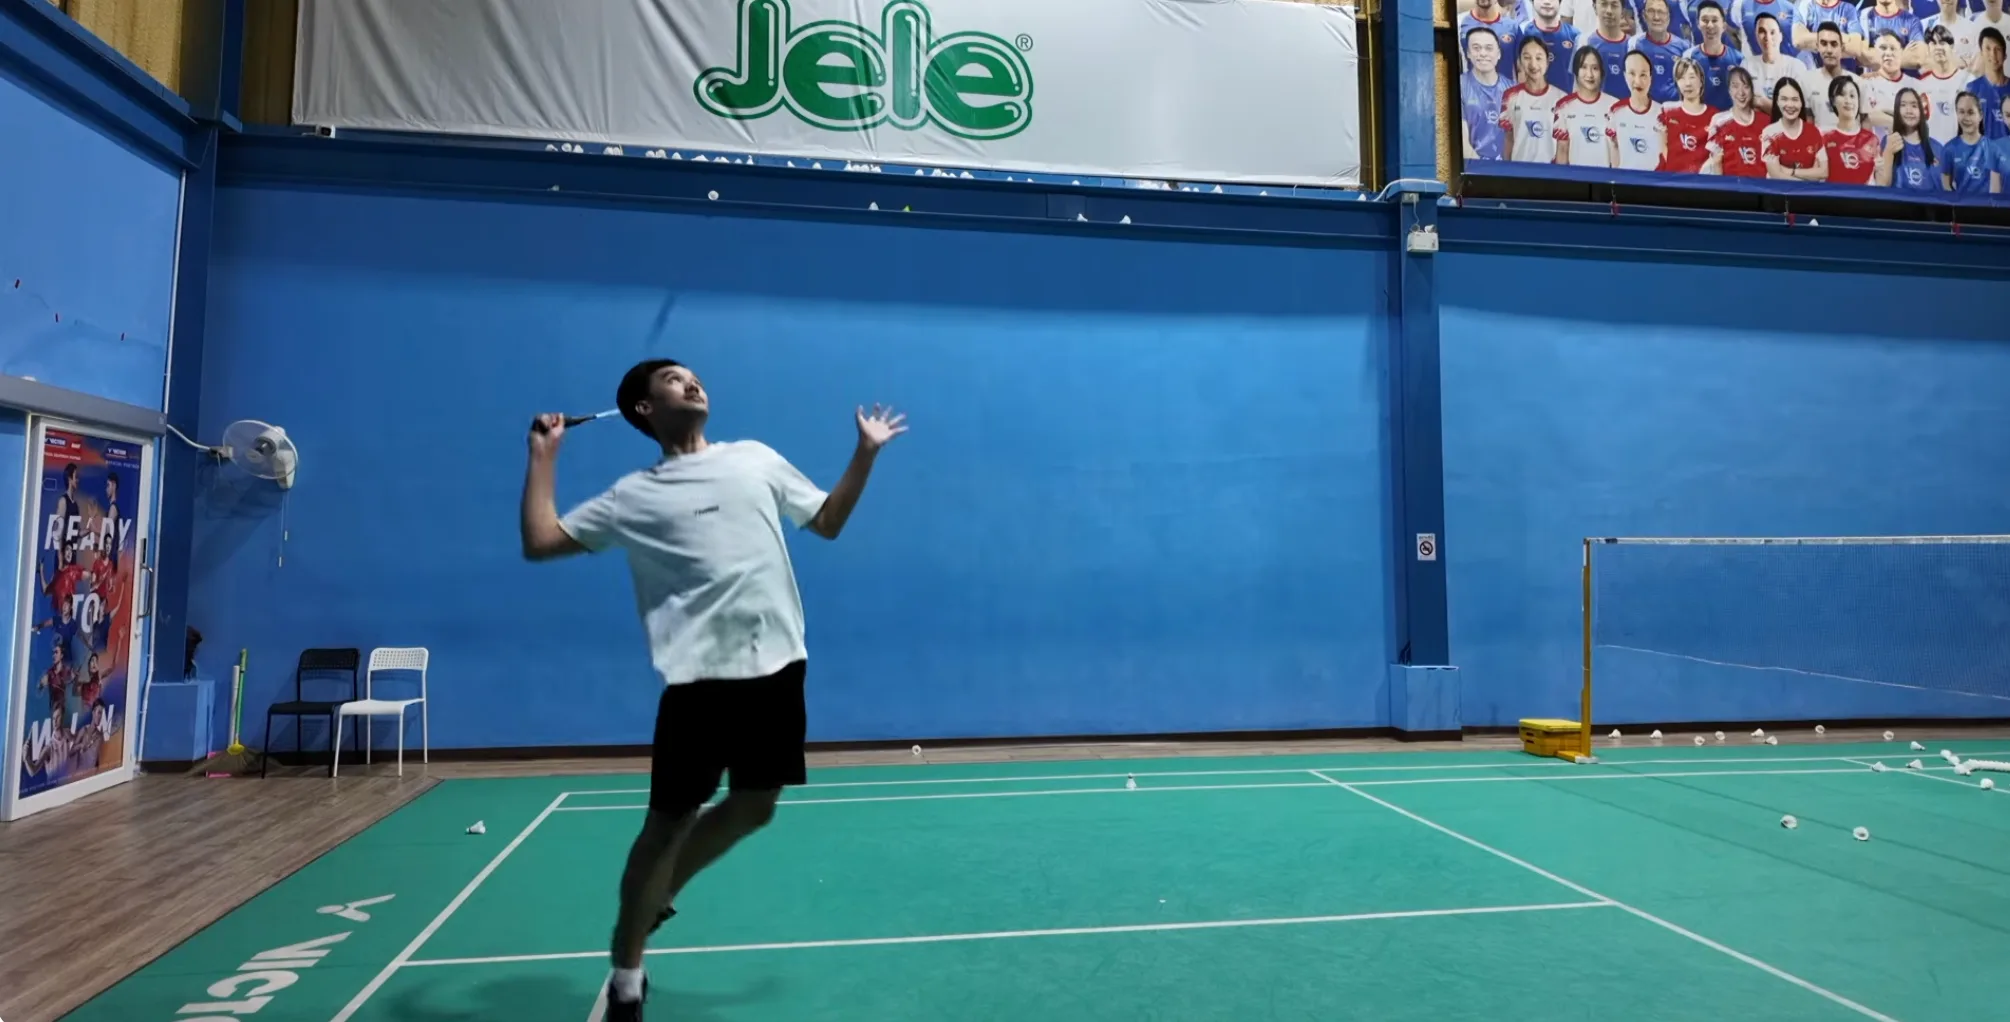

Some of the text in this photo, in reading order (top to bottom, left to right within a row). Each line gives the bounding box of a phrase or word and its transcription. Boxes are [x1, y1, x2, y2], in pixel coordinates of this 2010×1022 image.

[693, 0, 1034, 141] Jele
[44, 514, 132, 551] READY
[72, 593, 100, 633] TO
